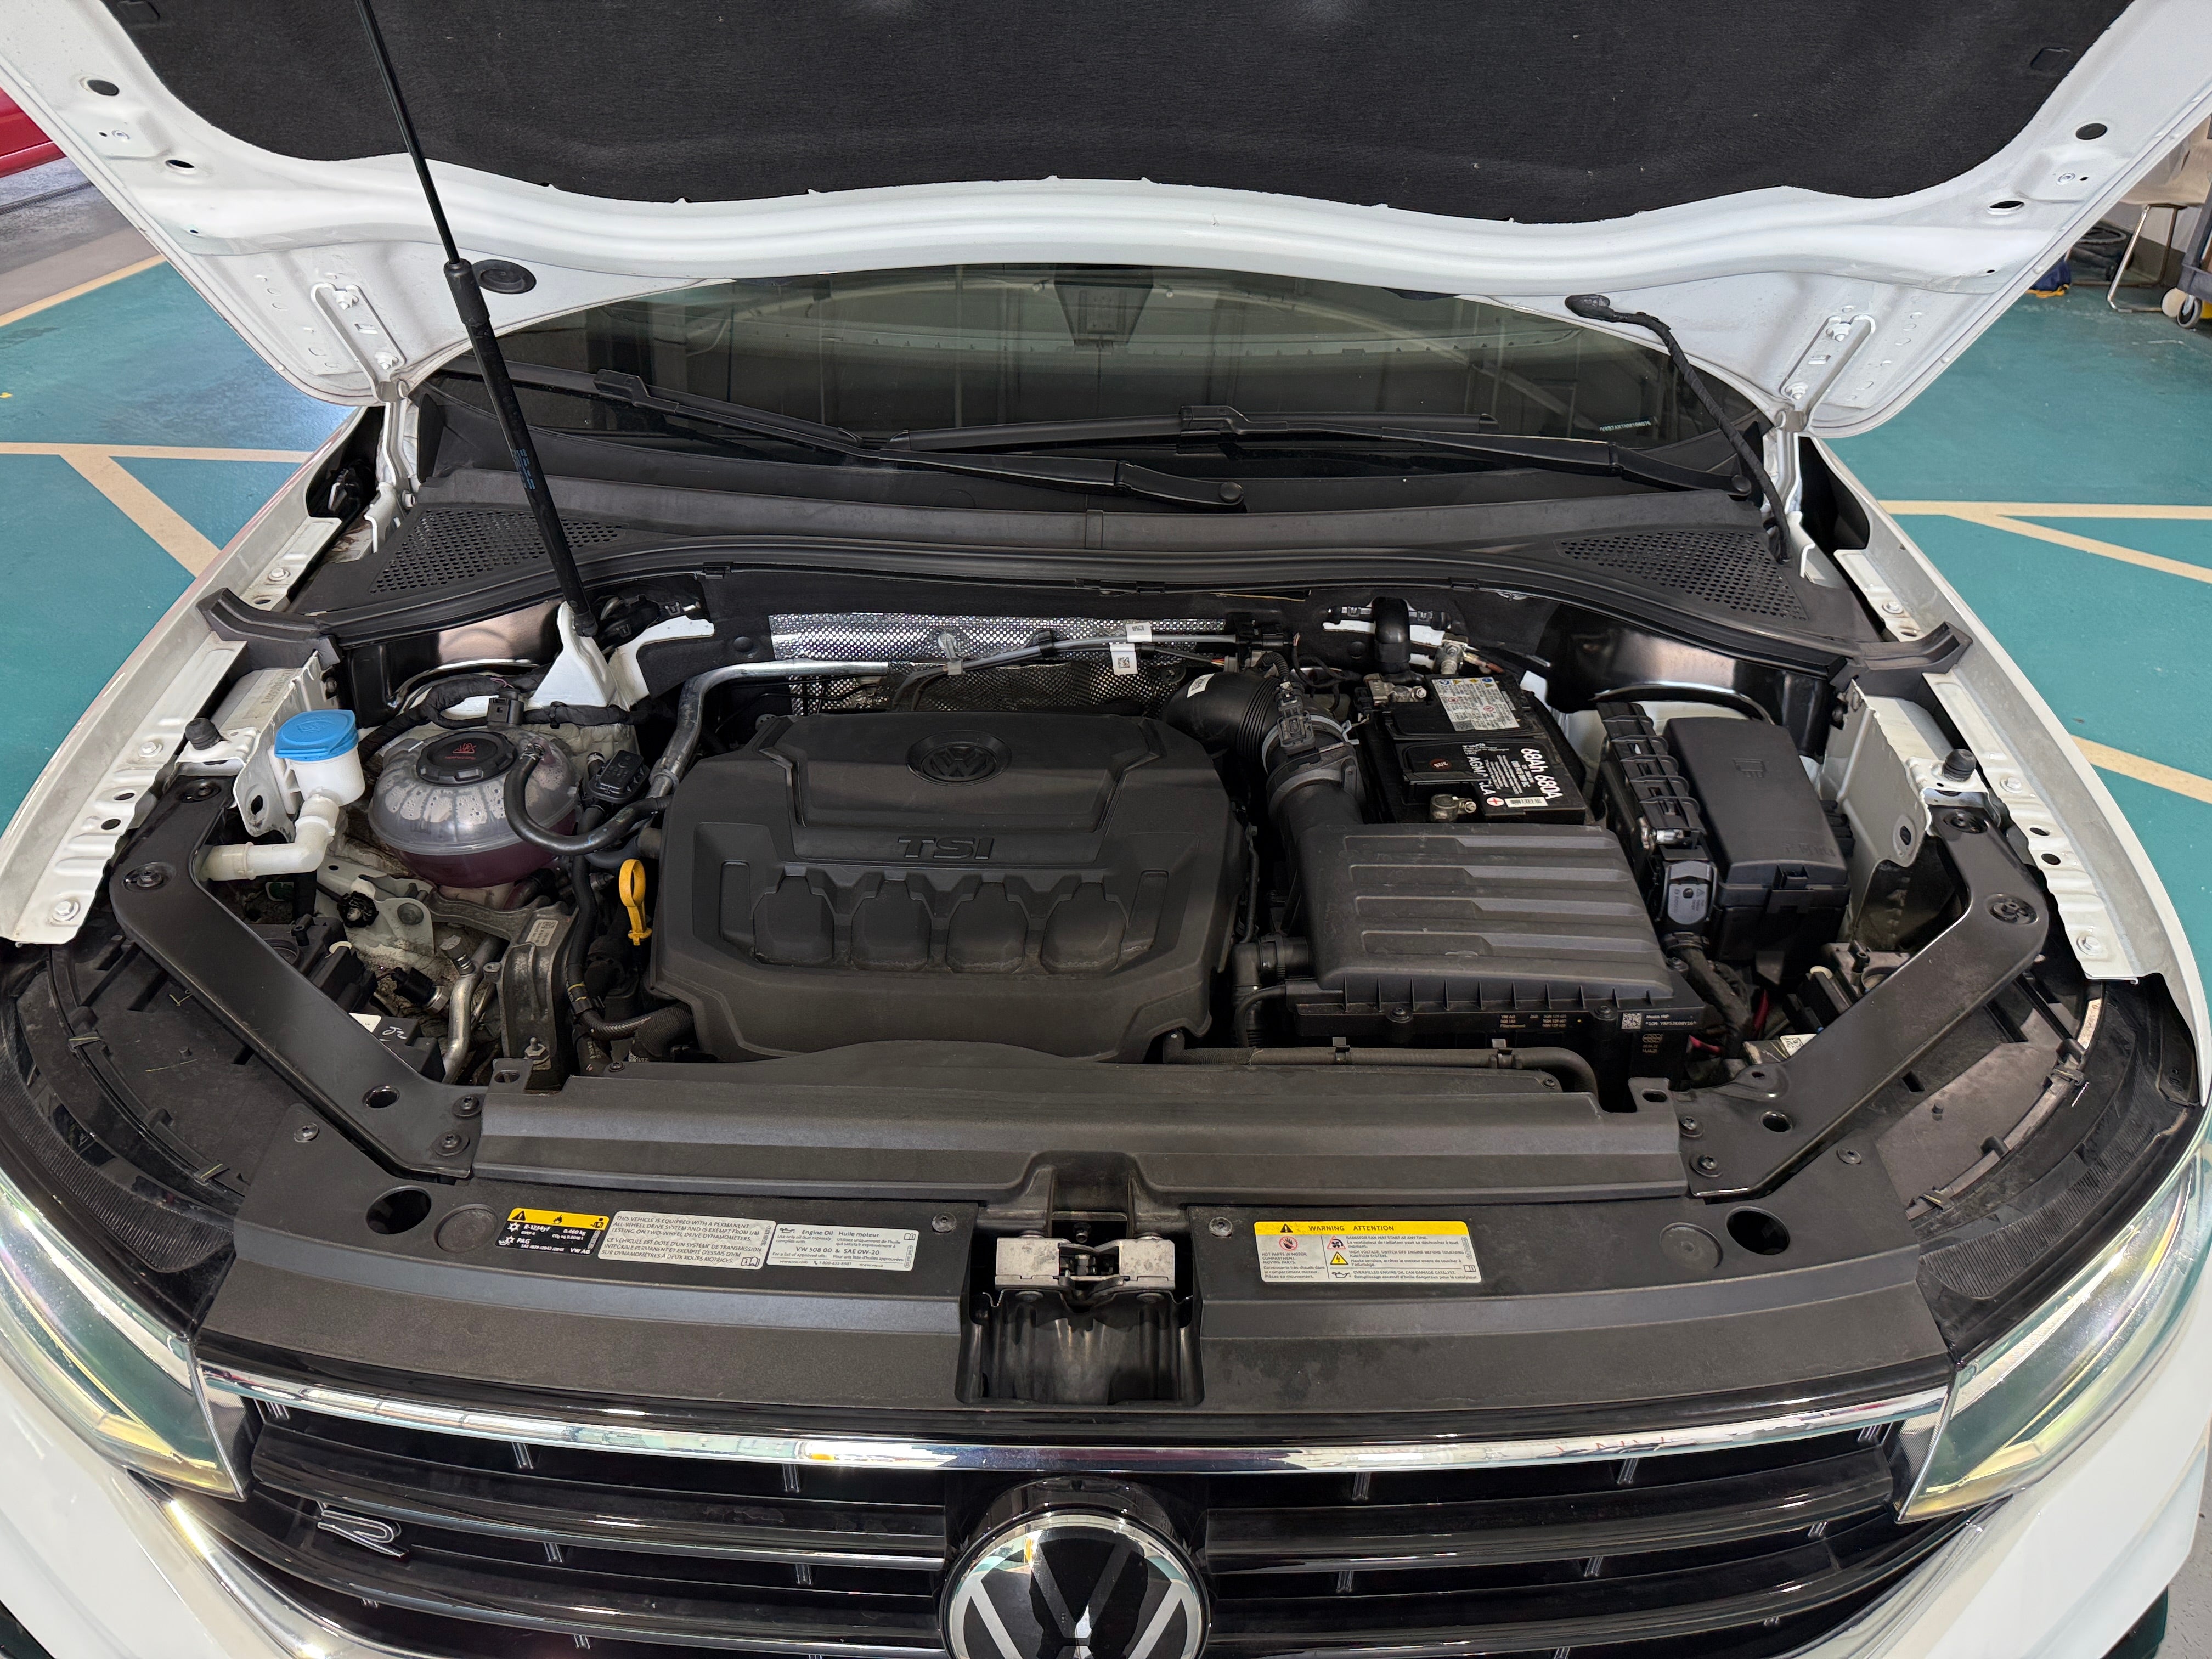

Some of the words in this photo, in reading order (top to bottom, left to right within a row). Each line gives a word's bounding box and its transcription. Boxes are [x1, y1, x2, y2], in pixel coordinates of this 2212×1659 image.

[1521, 748, 1548, 772] 68Ah
[1534, 775, 1564, 800] 680A
[898, 836, 995, 860] TSI
[523, 1224, 551, 1232] R-1234yf
[615, 1236, 642, 1244] VÉHICULE
[702, 1233, 752, 1242] DYNAMOMETERS.
